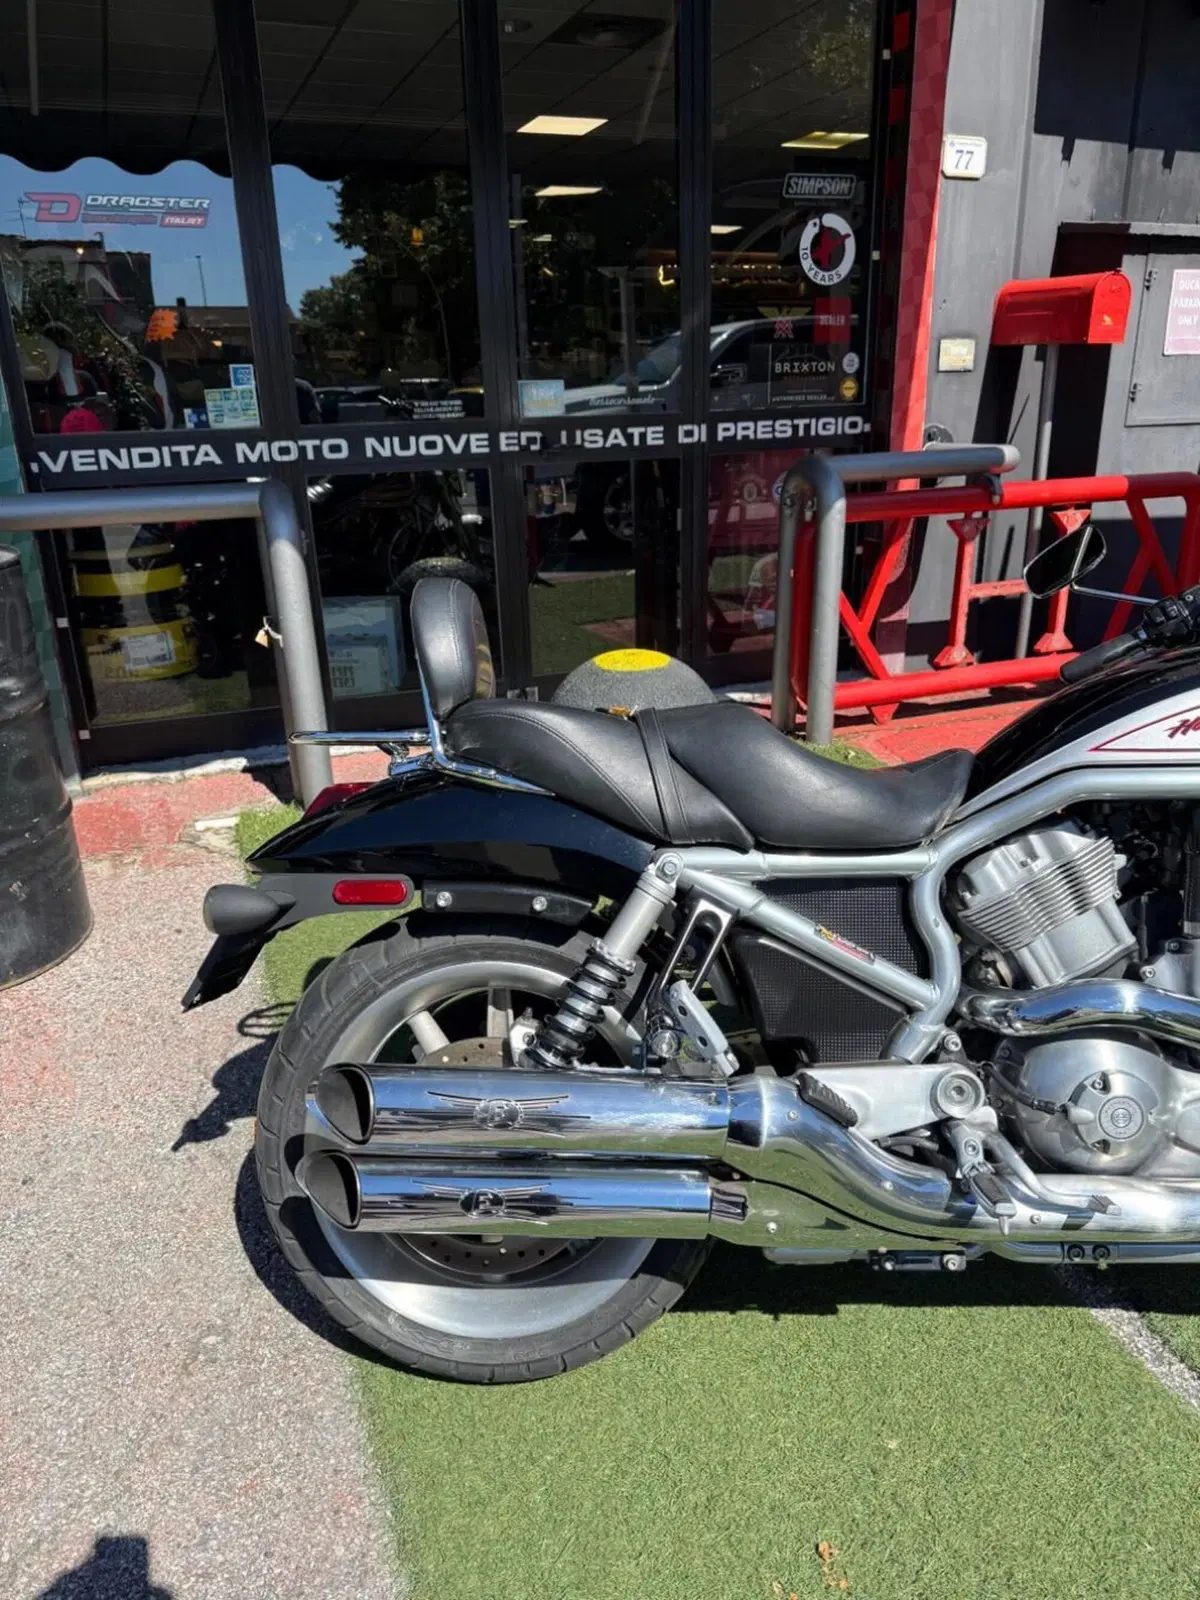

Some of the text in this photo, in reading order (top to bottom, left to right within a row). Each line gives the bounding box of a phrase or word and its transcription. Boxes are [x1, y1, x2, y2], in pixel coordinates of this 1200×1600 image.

[955, 149, 974, 170] 77
[788, 176, 851, 195] SIMPSON
[86, 194, 211, 209] DRAGSTER
[164, 216, 204, 225] ITALJET
[801, 246, 842, 283] 10 YEARS
[235, 438, 350, 464] MOTO
[364, 433, 490, 458] NUOVE
[678, 424, 707, 444] DI
